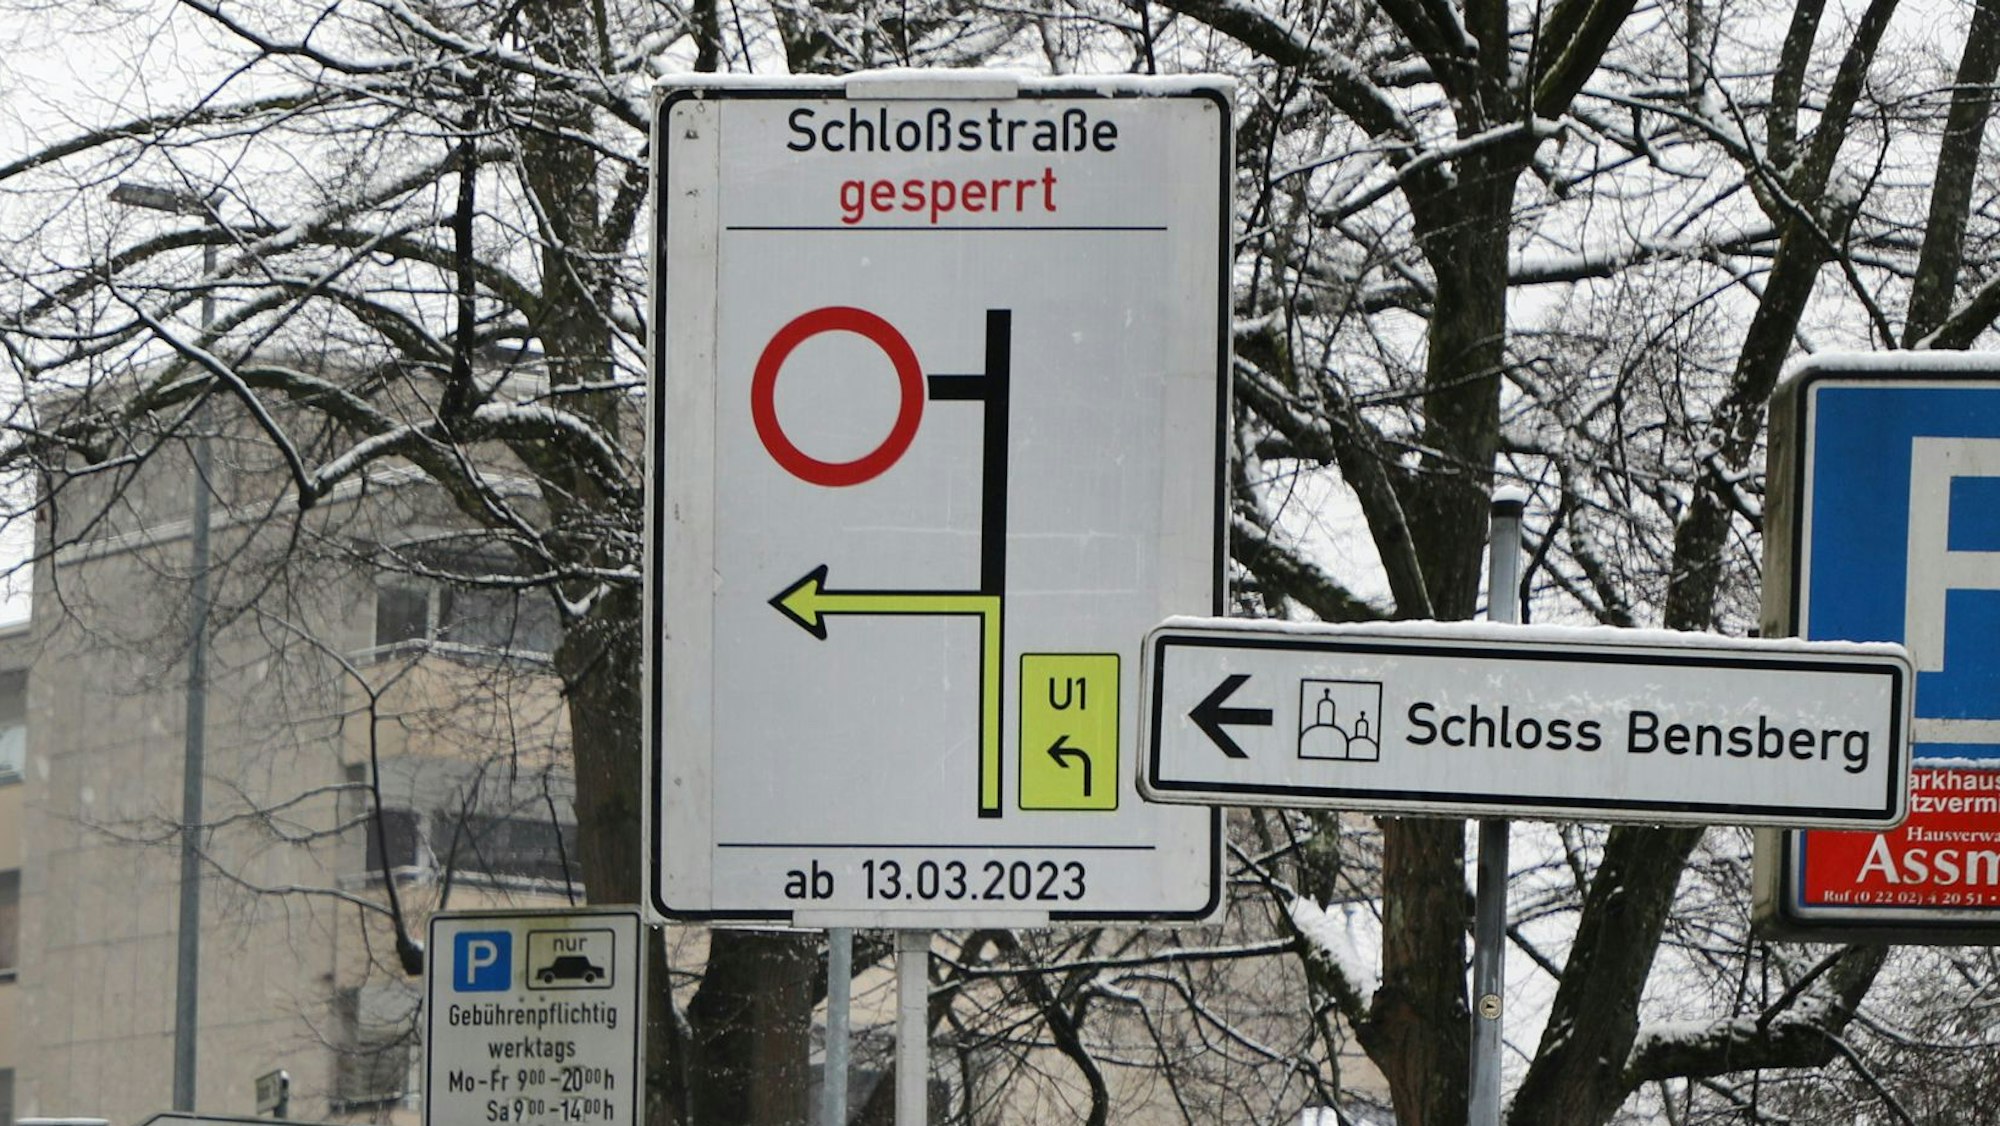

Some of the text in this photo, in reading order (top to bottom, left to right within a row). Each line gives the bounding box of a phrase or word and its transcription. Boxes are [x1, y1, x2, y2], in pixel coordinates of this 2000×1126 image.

[786, 108, 1118, 152] Schloßstraße
[840, 168, 1057, 225] gesperrt
[1049, 677, 1087, 711] U1
[1405, 701, 1870, 774] Schloss Bensberg
[784, 860, 1086, 901] ab 13.03.2023
[1823, 890, 1851, 903] Ruf
[1875, 892, 1893, 903] 22
[1942, 893, 1961, 905] 20
[552, 937, 588, 952] nur
[449, 1001, 617, 1030] Gebührenpflichtig
[488, 1037, 576, 1062] werktags
[487, 1101, 510, 1123] Sa
